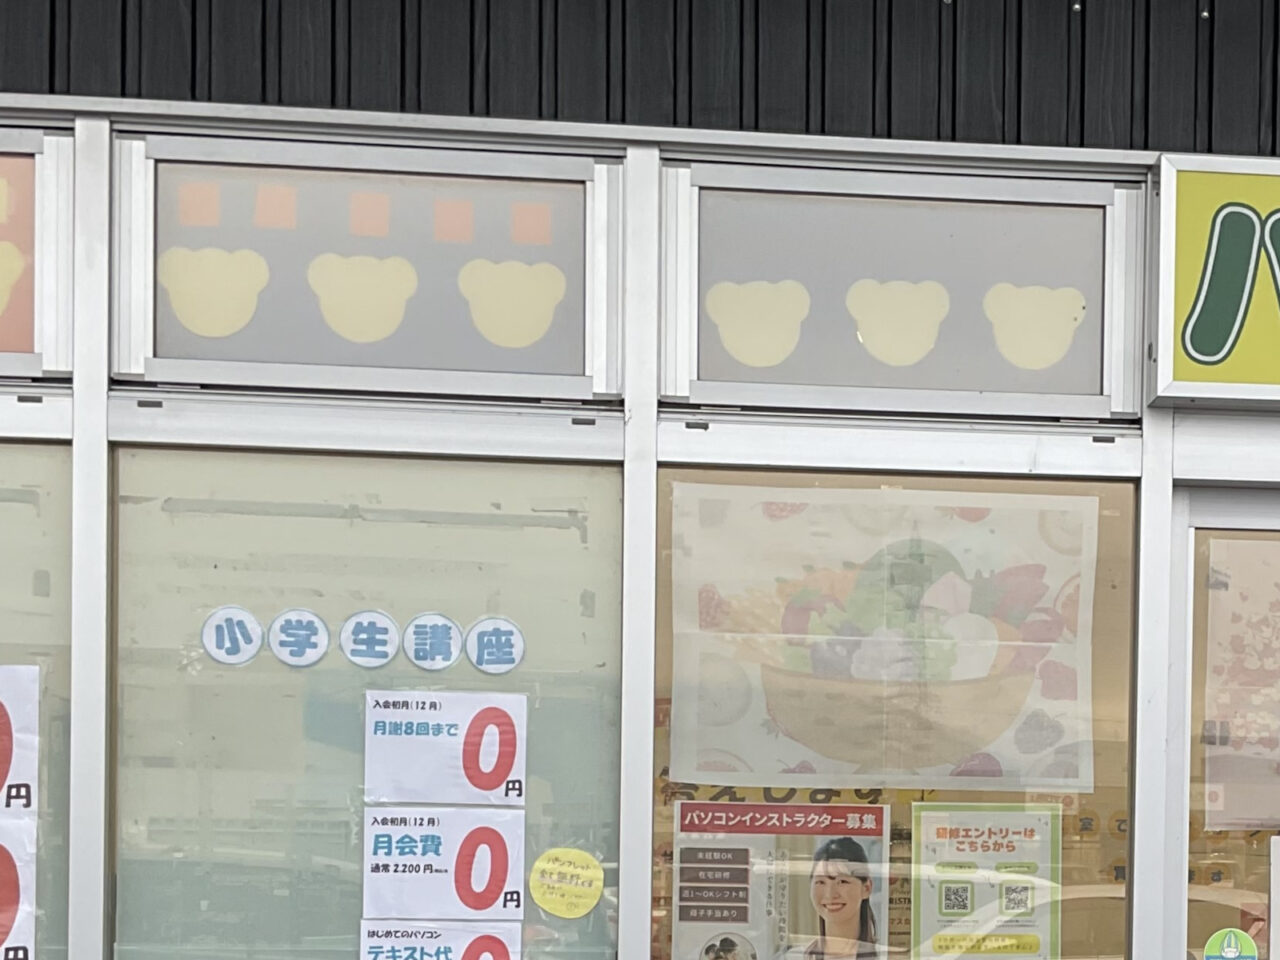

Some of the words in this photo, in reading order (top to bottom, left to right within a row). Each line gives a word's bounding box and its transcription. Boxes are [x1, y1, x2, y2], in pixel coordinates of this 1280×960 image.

[215, 617, 516, 667] 小学生講座
[373, 720, 459, 737] 月謝8回まで
[684, 812, 877, 829] パソコンインストラクター募集
[372, 833, 442, 857] 月会費
[955, 841, 1016, 853] こちらから
[367, 930, 441, 939] はじめてのパソコン
